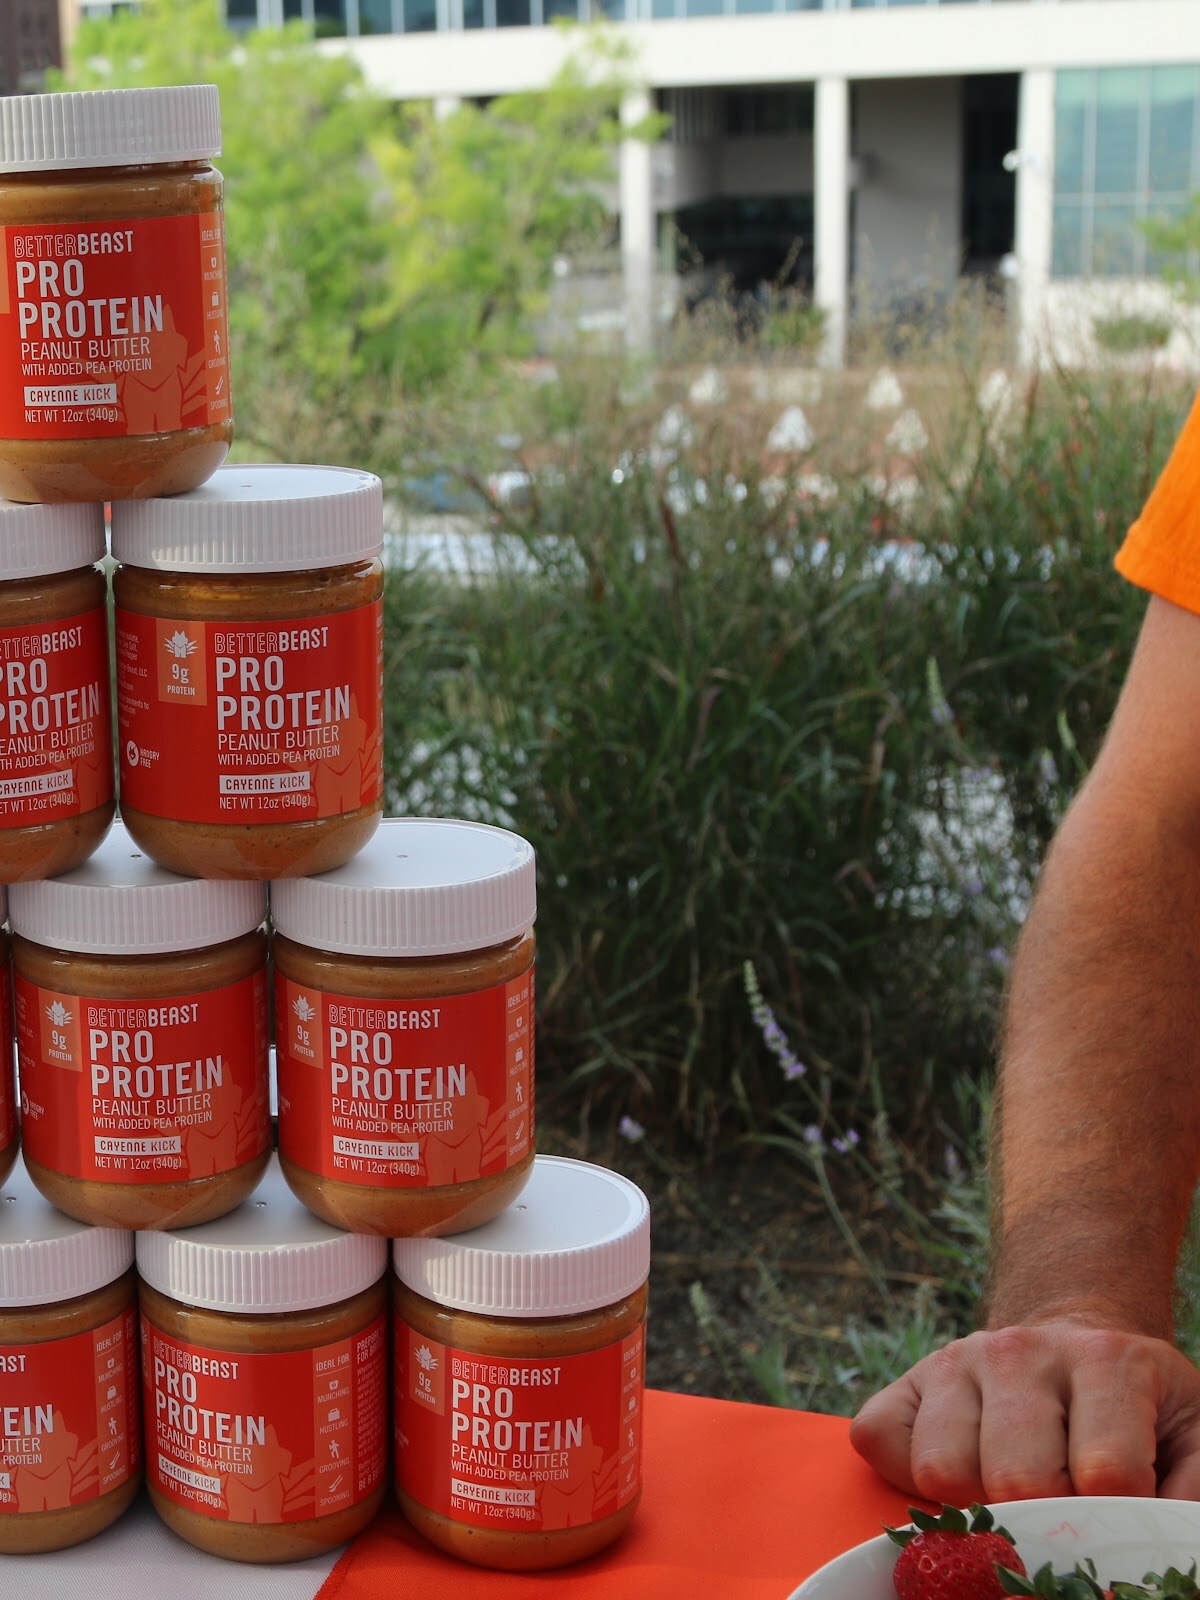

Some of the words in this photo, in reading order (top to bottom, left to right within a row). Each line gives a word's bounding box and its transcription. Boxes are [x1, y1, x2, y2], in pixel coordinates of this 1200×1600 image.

[14, 231, 133, 258] BETTERBEAST
[16, 259, 84, 298] PRO
[19, 295, 163, 339] PROTEIN
[21, 341, 82, 360] PEANUT
[89, 337, 150, 357] BUTTER
[22, 363, 46, 376] WITH
[48, 361, 82, 375] ADDED
[86, 360, 106, 373] PEA
[109, 358, 151, 372] PROTEIN
[30, 390, 78, 402] CAYENNE
[84, 388, 111, 401] KICK
[25, 409, 41, 423] NET
[44, 409, 59, 422] WT
[62, 409, 83, 422] 12oz
[86, 407, 118, 423] (340g)
[215, 627, 329, 654] BETTERBEAST
[172, 664, 189, 684] 9g
[216, 656, 284, 691] PRO
[167, 685, 195, 695] PROTEIN
[217, 685, 350, 731] PROTEIN
[52, 723, 93, 748] BUTTER
[219, 733, 280, 750] PEANUT
[286, 725, 339, 748] BUTTER
[16, 755, 46, 769] ADDED
[49, 752, 65, 764] PEA
[67, 742, 94, 761] PROTEIN
[218, 754, 242, 765] WITH
[245, 752, 280, 765] ADDED
[283, 751, 301, 764] PEA
[304, 745, 340, 761] PROTEIN
[48, 774, 69, 788] KICK
[226, 778, 275, 790] CAYENNE
[280, 775, 305, 788] KICK
[220, 797, 237, 809] NET
[240, 796, 254, 808] WT
[258, 796, 278, 808] 12oz
[281, 794, 311, 808] (340g)
[88, 1004, 198, 1028] BETTERBEAST
[329, 1005, 440, 1030] BETTERBEAST
[89, 1029, 153, 1063] PRO
[330, 1027, 392, 1065] PRO
[90, 1055, 223, 1098] PROTEIN
[331, 1062, 465, 1101] PROTEIN
[93, 1098, 150, 1116] PEANUT
[156, 1093, 211, 1116] BUTTER
[332, 1098, 387, 1119] PEANUT
[394, 1102, 452, 1120] BUTTER
[93, 1117, 115, 1129] WITH
[118, 1118, 150, 1129] ADDED
[154, 1117, 172, 1129] PEA
[175, 1111, 212, 1128] PROTEIN
[332, 1116, 353, 1130] WITH
[356, 1120, 388, 1133] ADDED
[391, 1122, 410, 1133] PEA
[413, 1119, 453, 1133] PROTEIN
[100, 1140, 146, 1152] CAYENNE
[151, 1140, 175, 1151] KICK
[339, 1140, 382, 1156] CAYENNE
[388, 1146, 413, 1156] KICK
[153, 1337, 238, 1380] BETTERBEAST
[154, 1356, 197, 1403] PRO
[452, 1358, 560, 1386] BETTERBEAST
[452, 1379, 513, 1418] PRO
[156, 1388, 265, 1445] PROTEIN
[157, 1419, 194, 1451] PEANUT
[199, 1439, 251, 1462] BUTTER
[452, 1411, 582, 1452] PROTEIN
[3, 1454, 42, 1465] PROTEIN
[452, 1443, 507, 1468] PEANUT
[513, 1452, 568, 1469] BUTTER
[161, 1458, 191, 1483] CAYENNE
[195, 1476, 216, 1489] KICK
[452, 1460, 472, 1475] WITH
[475, 1466, 506, 1480] ADDED
[509, 1471, 527, 1482] PEA
[530, 1469, 569, 1482] PROTEIN
[457, 1483, 500, 1500] CAYENNE
[505, 1492, 529, 1502] KICK
